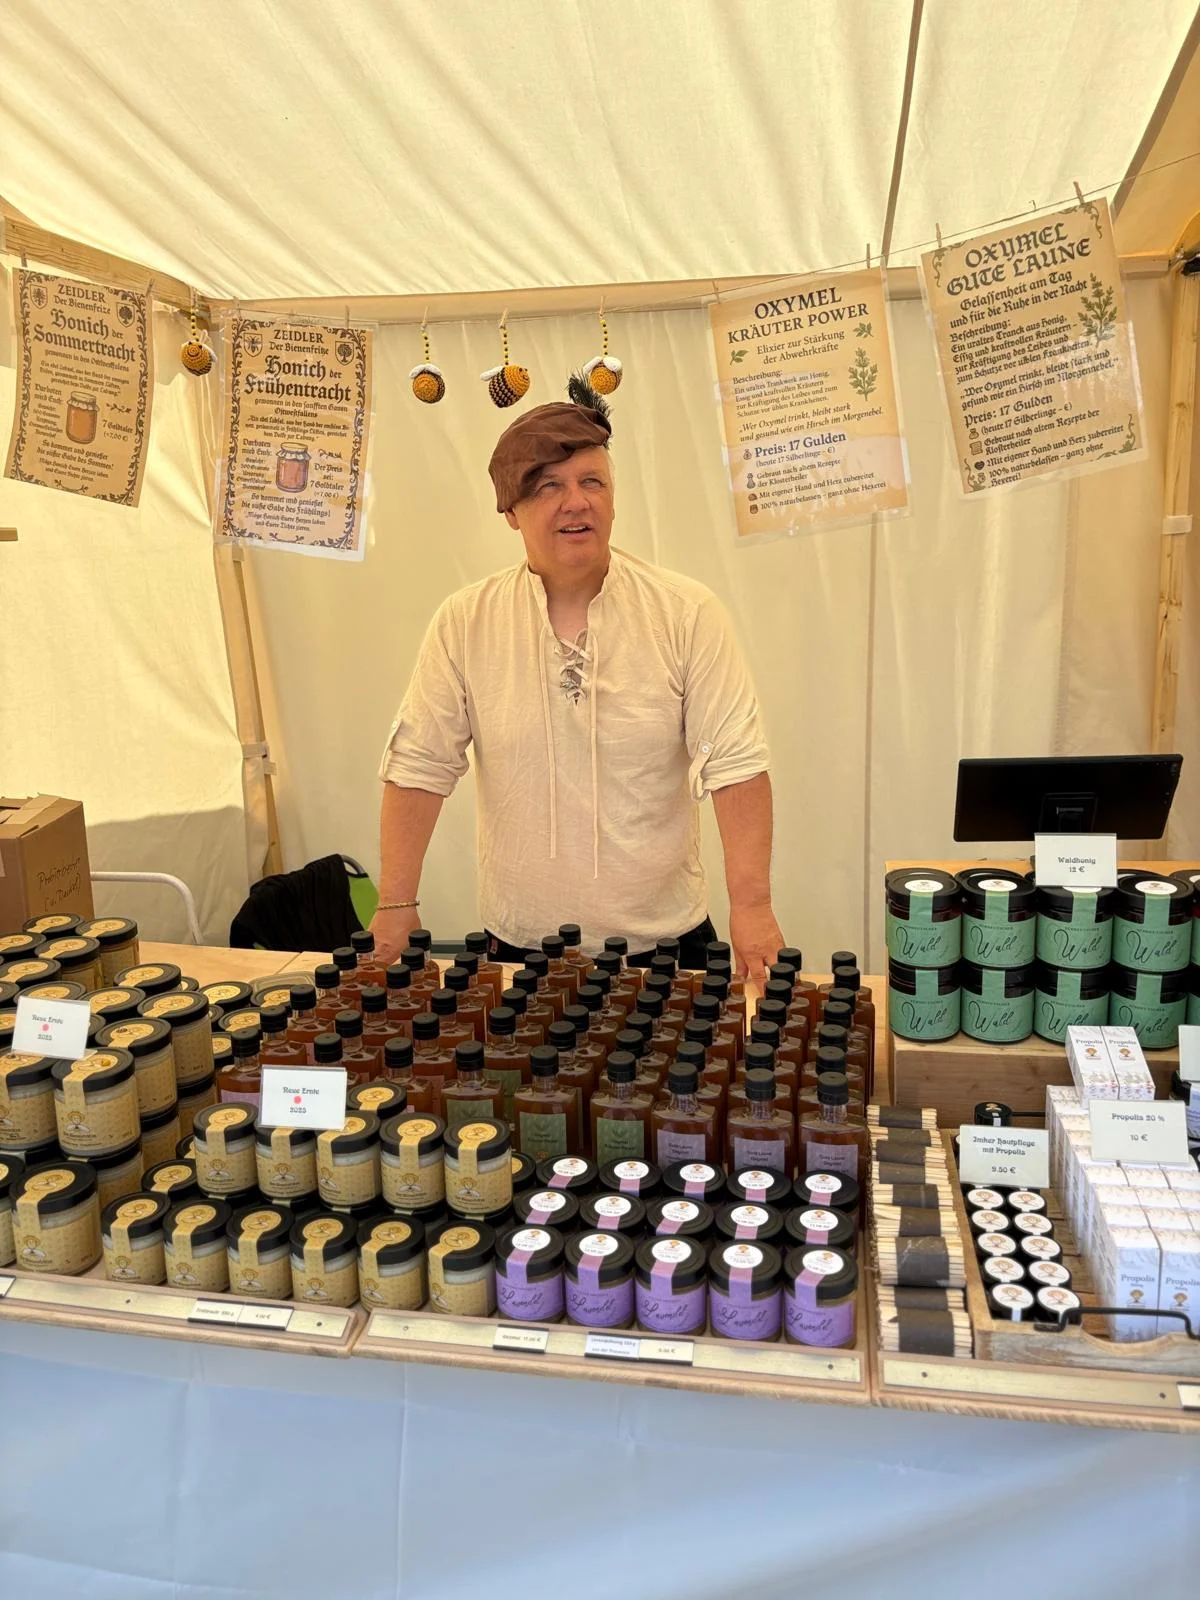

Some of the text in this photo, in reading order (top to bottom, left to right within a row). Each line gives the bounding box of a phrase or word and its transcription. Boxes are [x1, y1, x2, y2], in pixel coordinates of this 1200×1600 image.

[966, 223, 1069, 267] OXYMEL
[947, 238, 1090, 295] GUTE LAUNE
[1029, 279, 1046, 289] am
[1049, 271, 1071, 283] Tag
[53, 295, 67, 305] Der
[58, 284, 105, 302] ZEIDLER
[755, 287, 841, 318] OXYMEL
[950, 280, 1086, 328] und für die Ruhe in der Nacht
[51, 308, 123, 339] Honich der
[728, 303, 868, 343] KRÄUTER POWER
[34, 324, 134, 362] Sommertracht
[269, 341, 283, 350] Der
[274, 330, 323, 343] ZEIDLER
[757, 331, 844, 354] Elixier zur Stärkung
[951, 322, 1040, 352] Ein uraltes aus
[975, 346, 989, 356] und
[1035, 324, 1070, 339] Kräutern
[763, 342, 838, 364] der Abwehrkräfte
[955, 364, 967, 374] zur
[1013, 348, 1025, 356] des
[1027, 340, 1052, 352] Leibes
[1054, 334, 1068, 344] und
[1094, 349, 1109, 360] und
[265, 355, 341, 381] Honich der
[957, 373, 972, 384] zum
[1003, 361, 1015, 369] vor
[245, 374, 350, 403] Frühentracht
[990, 377, 1054, 400] wie ein im
[759, 416, 786, 428] Oxymel
[964, 395, 1052, 428] Preis: 17 Gulden
[1005, 419, 1011, 427] 17
[740, 432, 753, 441] und
[755, 433, 845, 457] Preis: 17 Gulden
[984, 432, 1014, 446] Gebraut
[1016, 427, 1032, 438] nach
[1034, 423, 1054, 432] altem
[987, 457, 1002, 466] Mit
[1004, 451, 1029, 462] eigener
[1031, 443, 1051, 455] Hand
[1053, 439, 1067, 449] und
[795, 483, 811, 491] Hand
[1057, 856, 1096, 865] Waldhonig
[896, 926, 942, 959] Wald
[970, 925, 1018, 959] Wald
[1054, 929, 1103, 962] Wald
[1126, 930, 1178, 964] Wald
[901, 1001, 948, 1033] Wald
[968, 1000, 1015, 1033] Wald
[1111, 1112, 1144, 1122] Propolis
[1141, 1133, 1149, 1141] €
[995, 1147, 1026, 1156] Propolis
[1010, 1166, 1017, 1174] €
[1120, 1273, 1155, 1285] Propolis
[1166, 1277, 1200, 1287] Propolis
